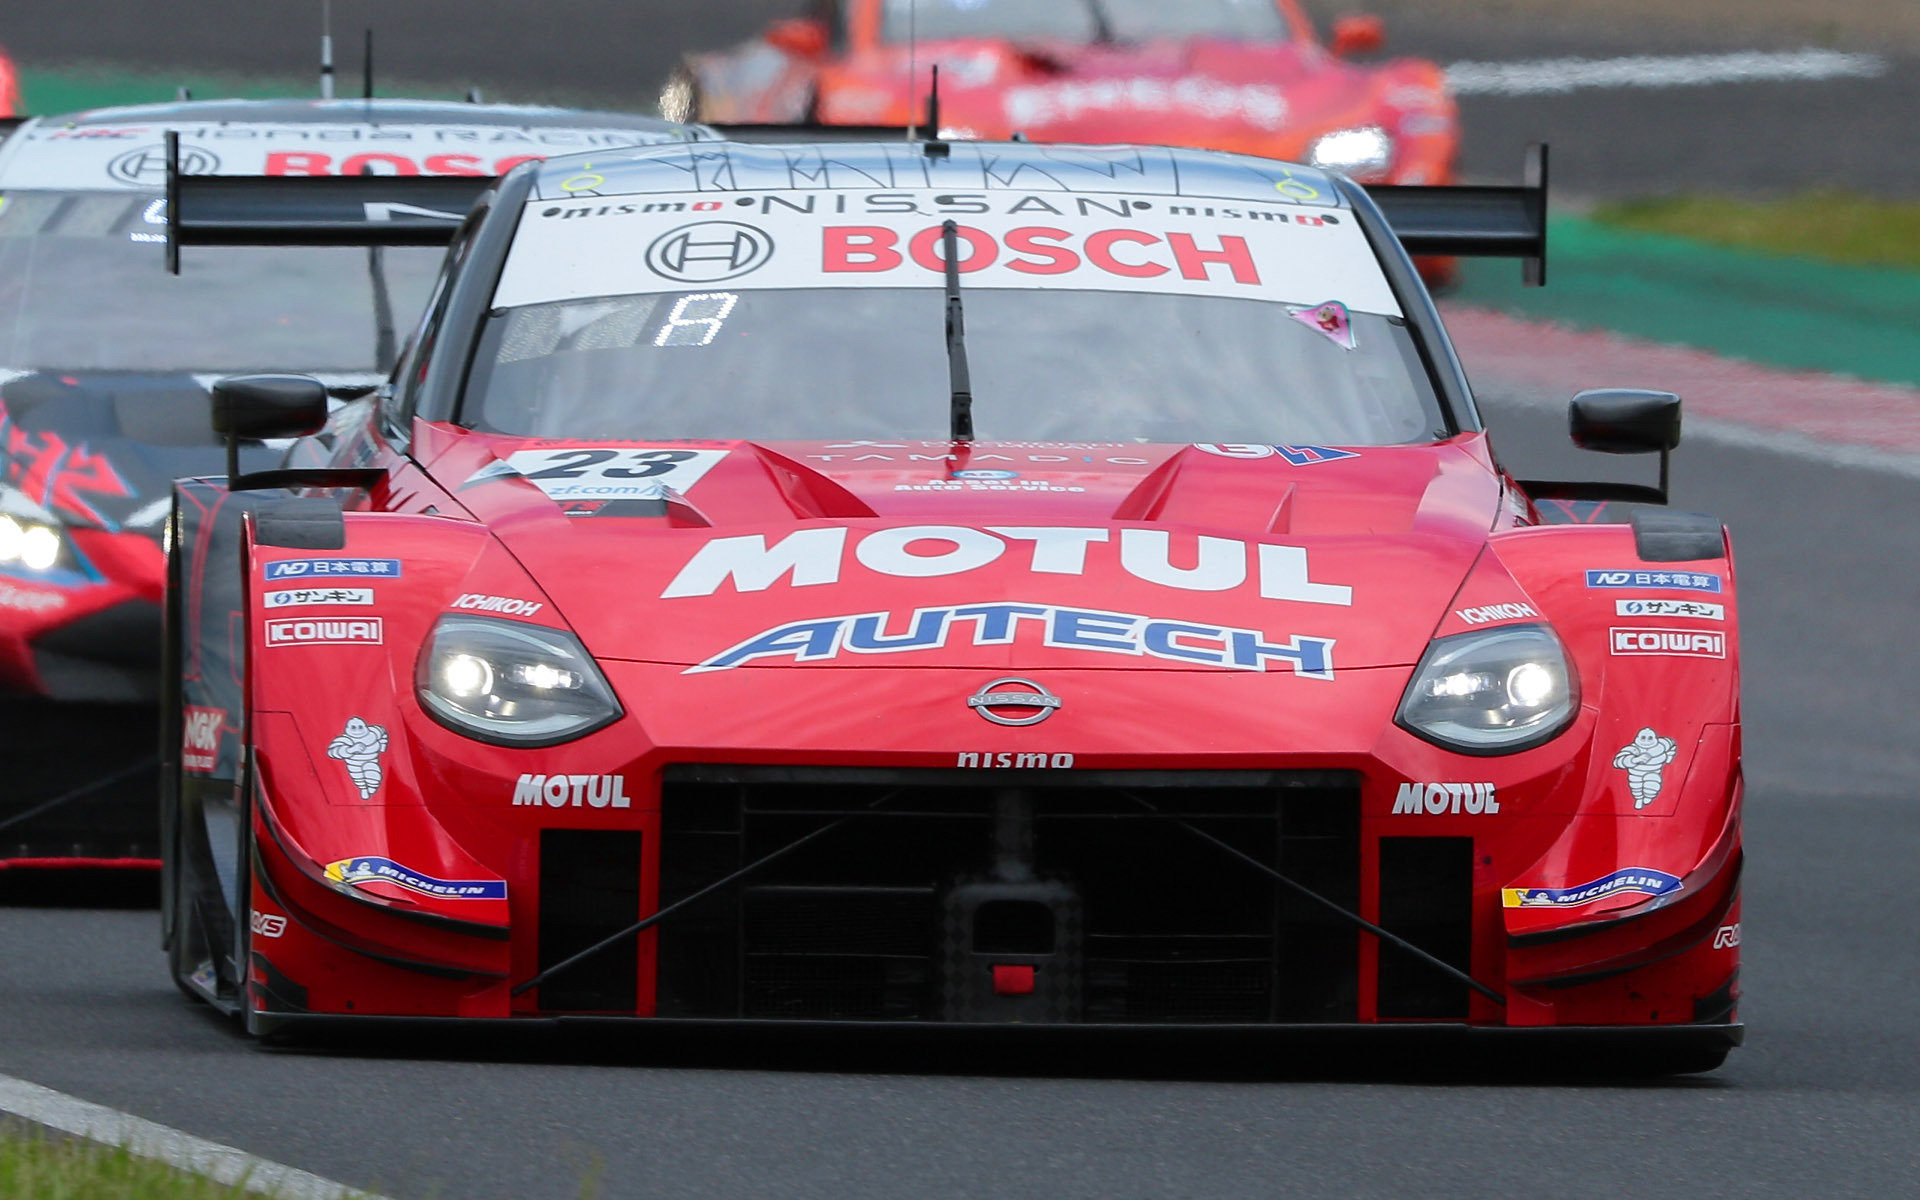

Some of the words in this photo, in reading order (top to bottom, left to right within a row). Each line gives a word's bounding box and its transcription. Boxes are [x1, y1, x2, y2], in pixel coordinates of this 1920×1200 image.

[562, 200, 723, 220] nismo
[761, 194, 1134, 217] NISSAN
[1169, 205, 1324, 226] nismo
[821, 225, 1262, 286] BOSCH
[527, 449, 700, 479] 23
[893, 484, 962, 492] Auto
[313, 560, 390, 573] 日本電算
[660, 525, 1353, 606] MOTUL
[1635, 573, 1710, 587] 日本電算
[294, 590, 364, 603] サンキン
[451, 593, 543, 617] ICHIKOH
[1455, 602, 1538, 625] ICHIKOH
[1645, 602, 1715, 616] サンキン
[681, 601, 1336, 681] AUTECH
[970, 694, 1060, 706] NISSAN
[956, 751, 1075, 769] nismo
[512, 773, 631, 808] MOTUL
[1392, 783, 1500, 815] MOTUL
[376, 863, 486, 896] MICHELIN
[1557, 876, 1664, 903] MICHELIN
